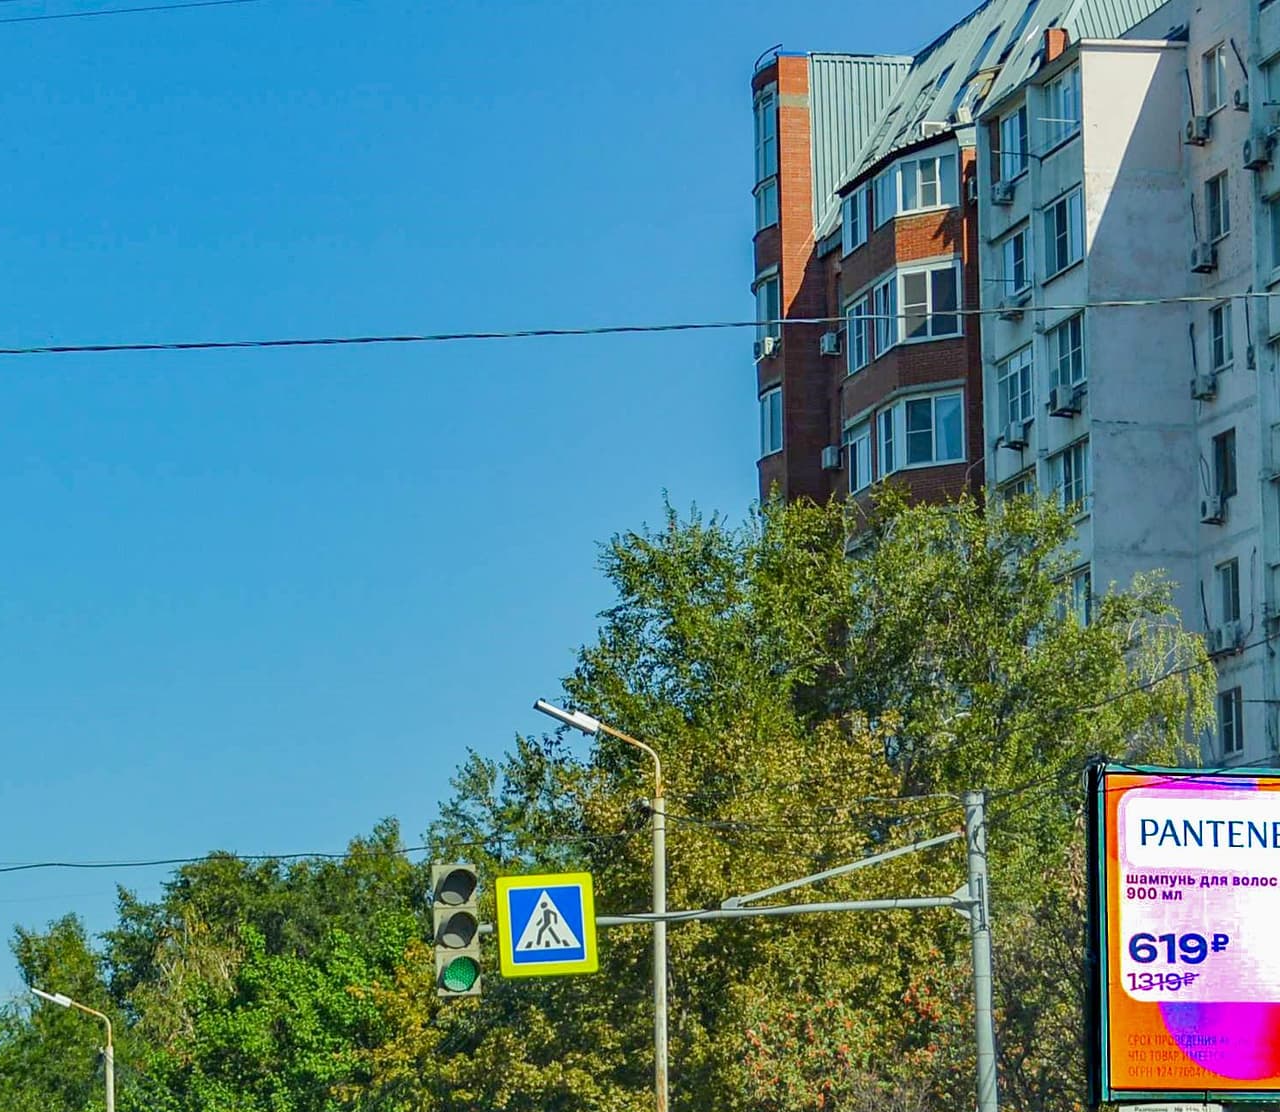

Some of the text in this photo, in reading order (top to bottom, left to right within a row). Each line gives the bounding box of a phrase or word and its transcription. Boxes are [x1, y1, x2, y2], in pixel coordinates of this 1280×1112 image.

[1126, 873, 1278, 888] шампунь для волос
[1126, 886, 1183, 901] 900 мл
